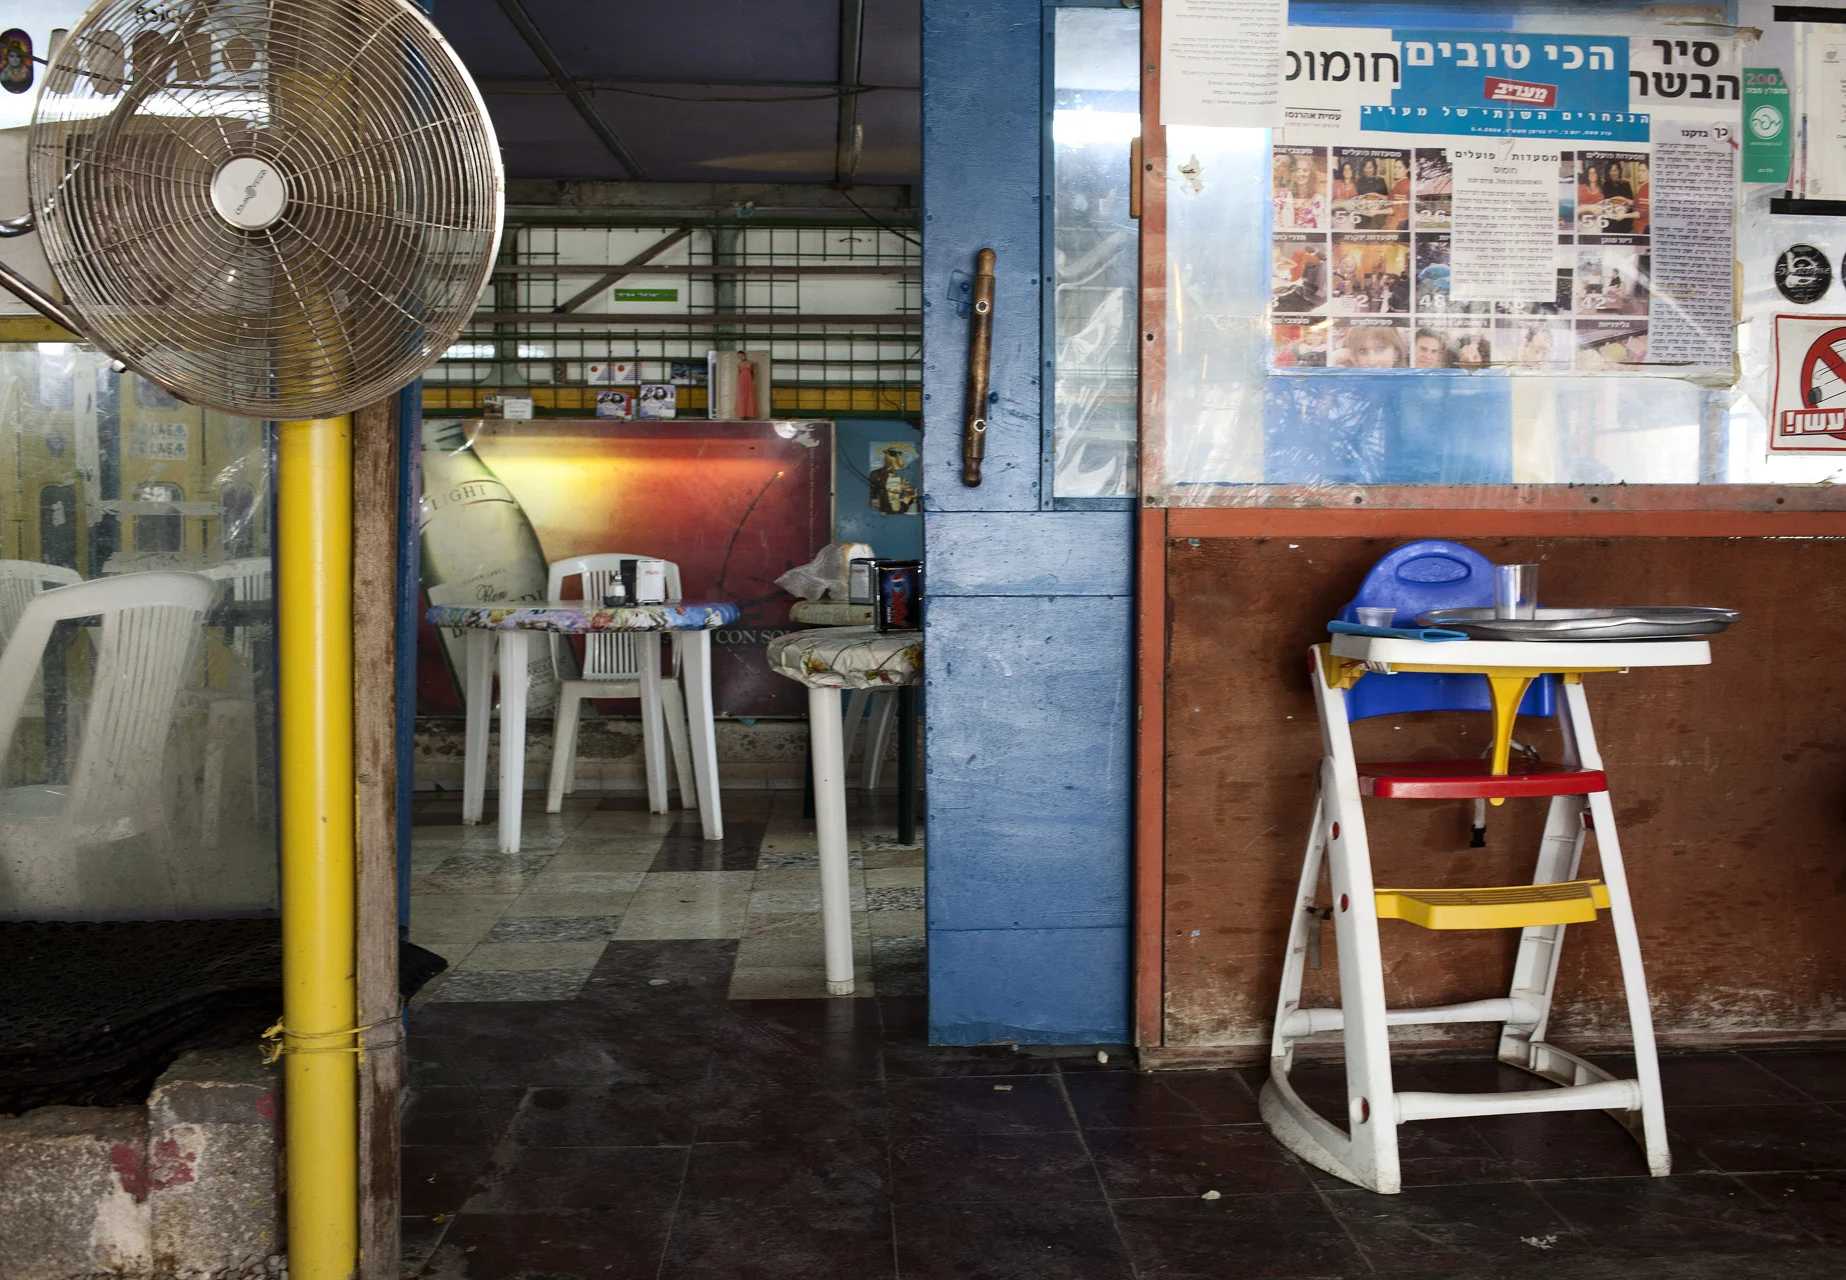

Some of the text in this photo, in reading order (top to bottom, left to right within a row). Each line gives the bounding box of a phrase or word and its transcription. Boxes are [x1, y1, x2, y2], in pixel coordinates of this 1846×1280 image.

[1405, 41, 1615, 70] הכי טובים
[1652, 39, 1720, 67] סיר
[1494, 82, 1548, 99] מעריב
[1629, 70, 1740, 101] הבשר
[1363, 106, 1428, 117] מעריב
[1442, 106, 1468, 117] של
[1482, 109, 1547, 121] השנתי
[1681, 127, 1728, 139] כך בדקנו
[1455, 150, 1559, 161] מסעדות פועלים
[1334, 210, 1362, 224] 56
[1419, 209, 1446, 222] 26
[1581, 214, 1610, 228] 56
[1419, 294, 1446, 308] 48
[1786, 409, 1846, 434] עשן!
[431, 484, 487, 511] LIGHT
[715, 629, 792, 644] CON SO
